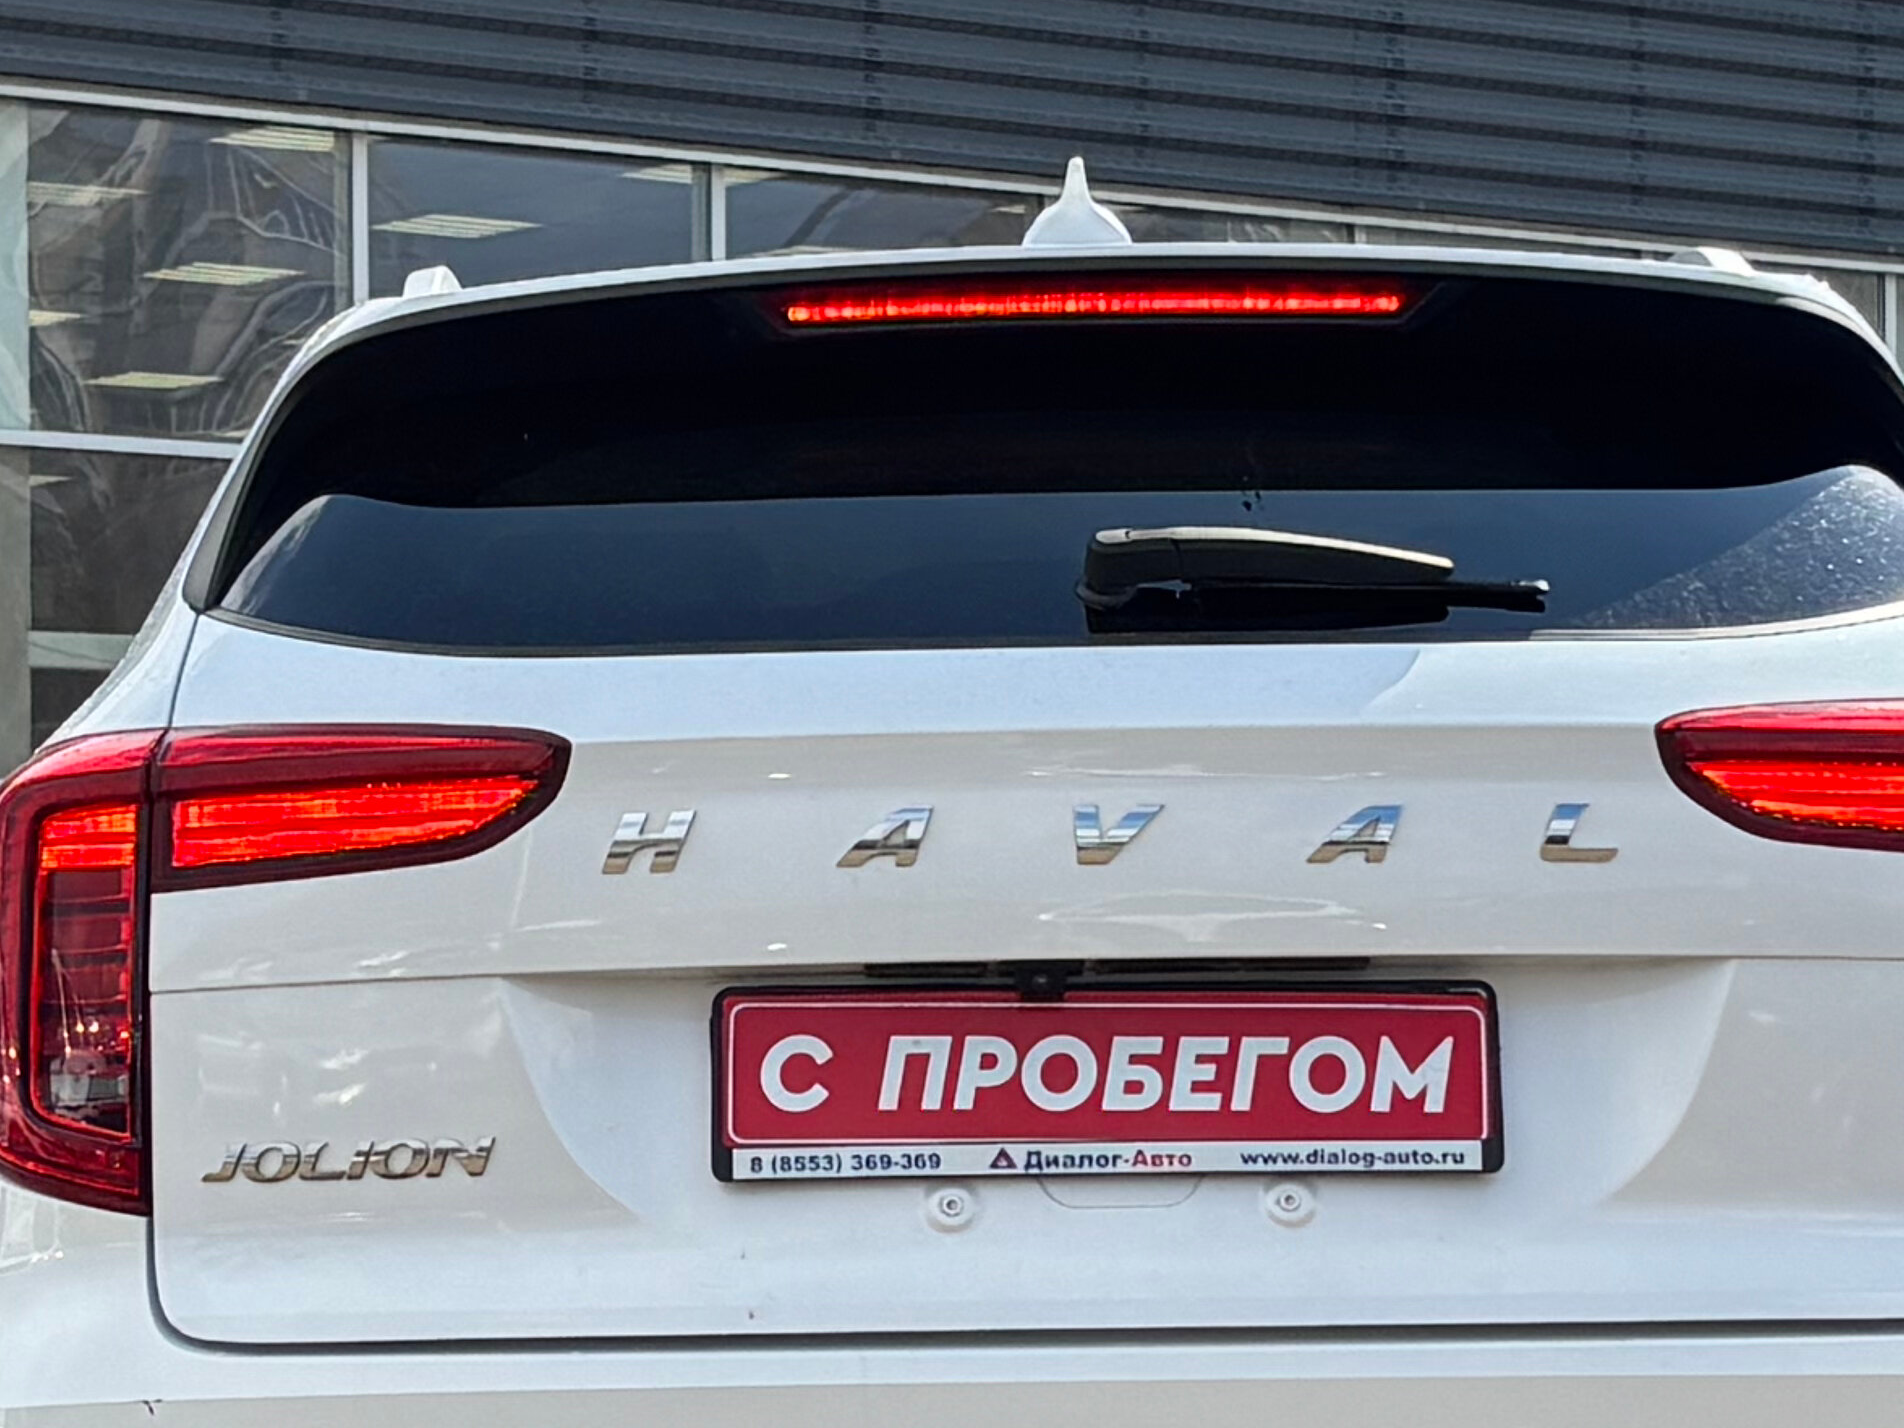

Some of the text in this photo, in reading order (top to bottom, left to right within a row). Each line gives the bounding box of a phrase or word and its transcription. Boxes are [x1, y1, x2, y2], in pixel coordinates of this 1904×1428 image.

[601, 803, 1620, 876] HAVAL
[758, 1033, 1455, 1115] С ПРОБЕГОМ
[201, 1135, 497, 1184] JOLION
[749, 1152, 942, 1174] 8 (8553) 369-369
[1023, 1148, 1193, 1173] Диалог-Авто
[1239, 1148, 1466, 1169] www.dialog-auto.ru
